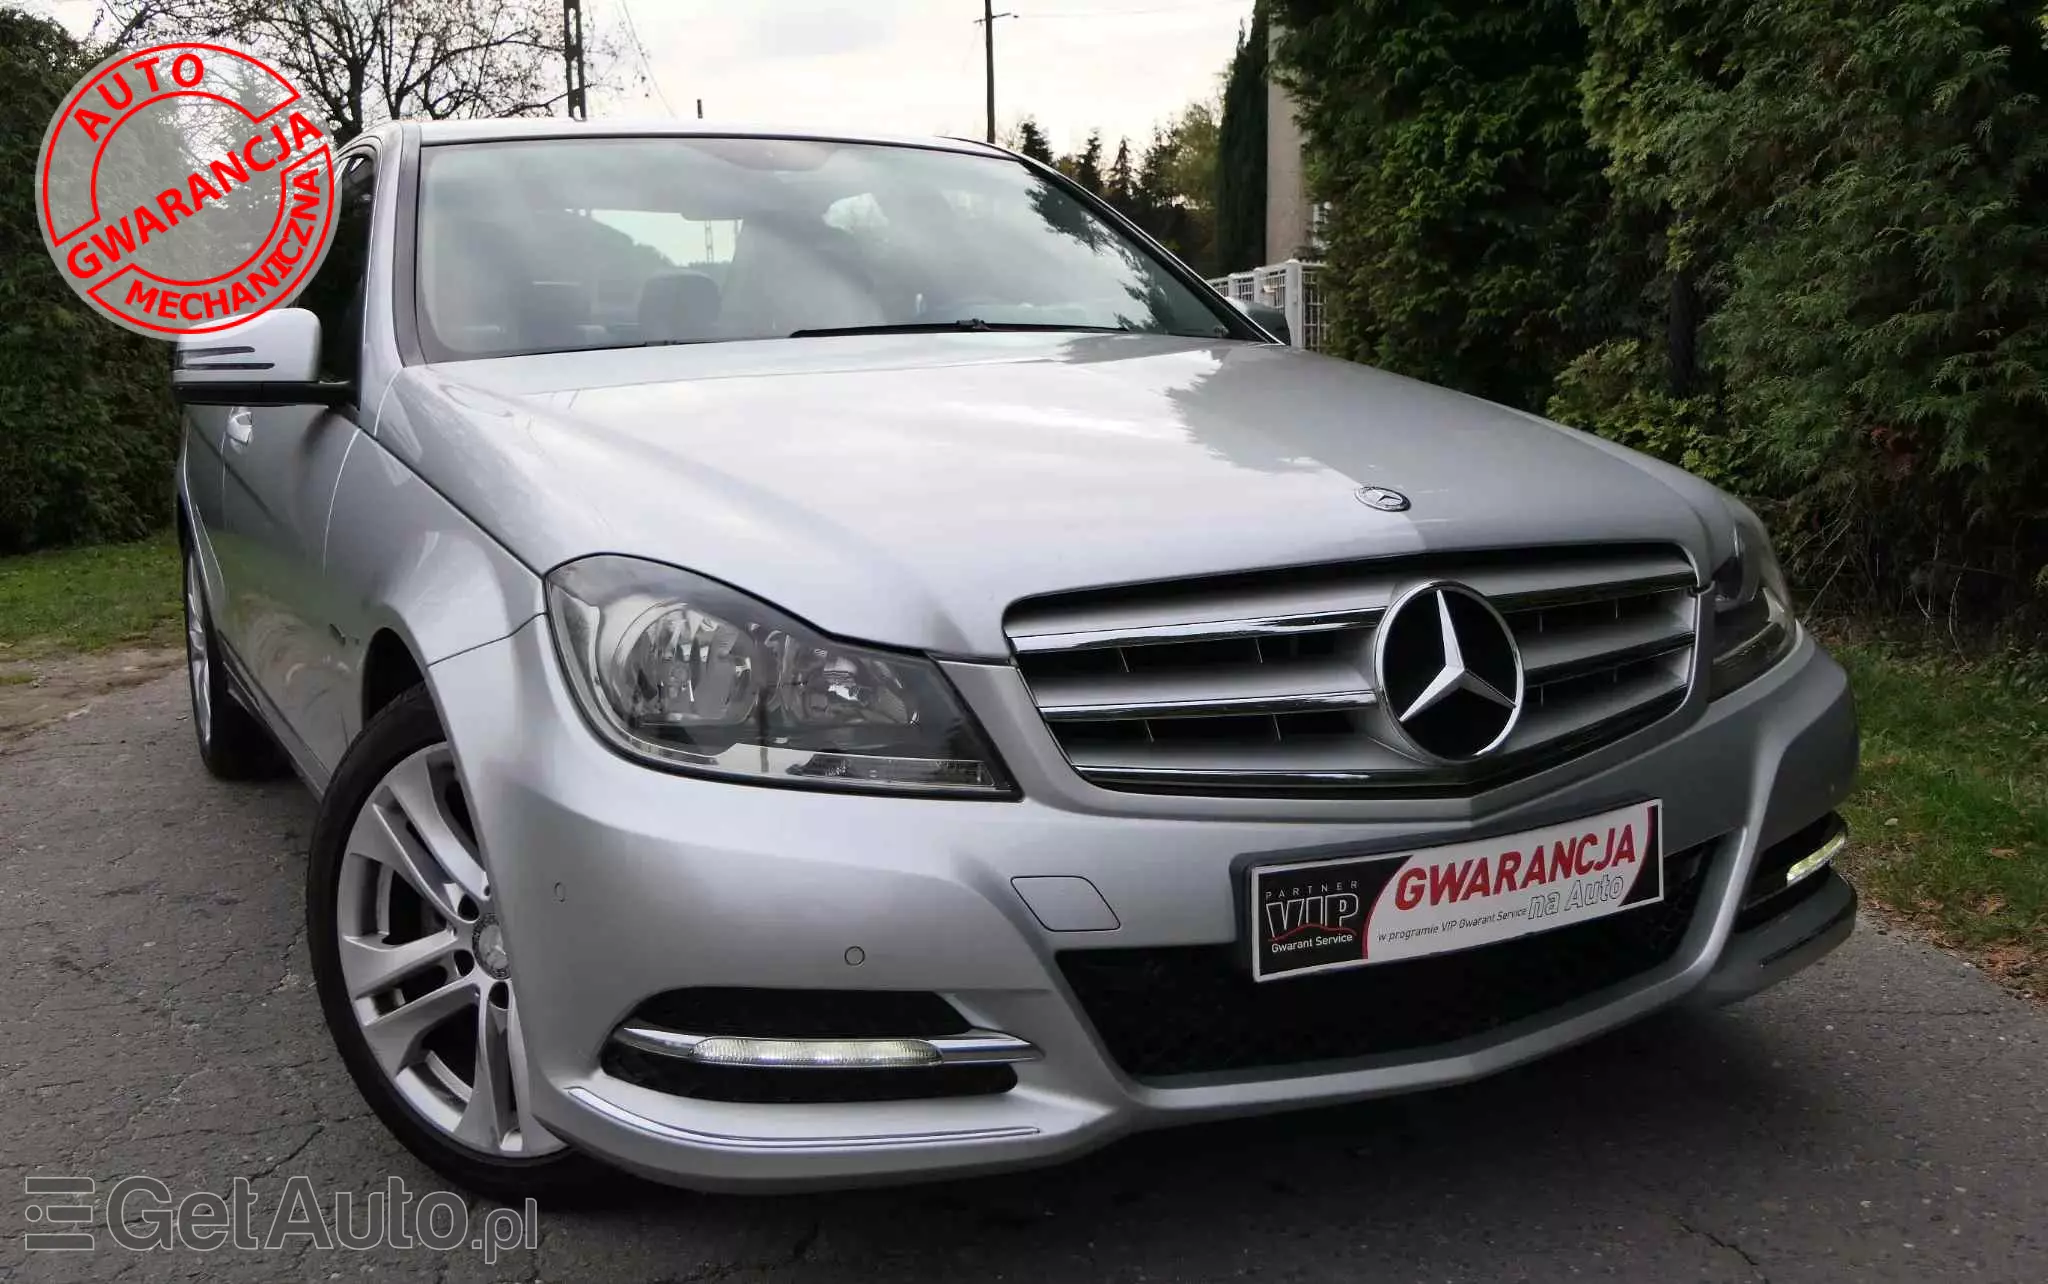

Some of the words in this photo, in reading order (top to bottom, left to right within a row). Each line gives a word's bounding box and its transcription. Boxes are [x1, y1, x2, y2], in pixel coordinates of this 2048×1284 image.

[1394, 823, 1636, 912] GWARANCJA
[1265, 880, 1359, 900] PARTNER
[1528, 891, 1561, 920] na
[1564, 873, 1625, 912] Auto
[1265, 892, 1359, 938] VIP
[1388, 923, 1439, 943] programie
[1441, 919, 1458, 933] VIP
[1458, 913, 1496, 930] Gwarant
[1496, 906, 1528, 922] Service
[1271, 938, 1313, 953] Gwarant
[1315, 932, 1353, 947] Service
